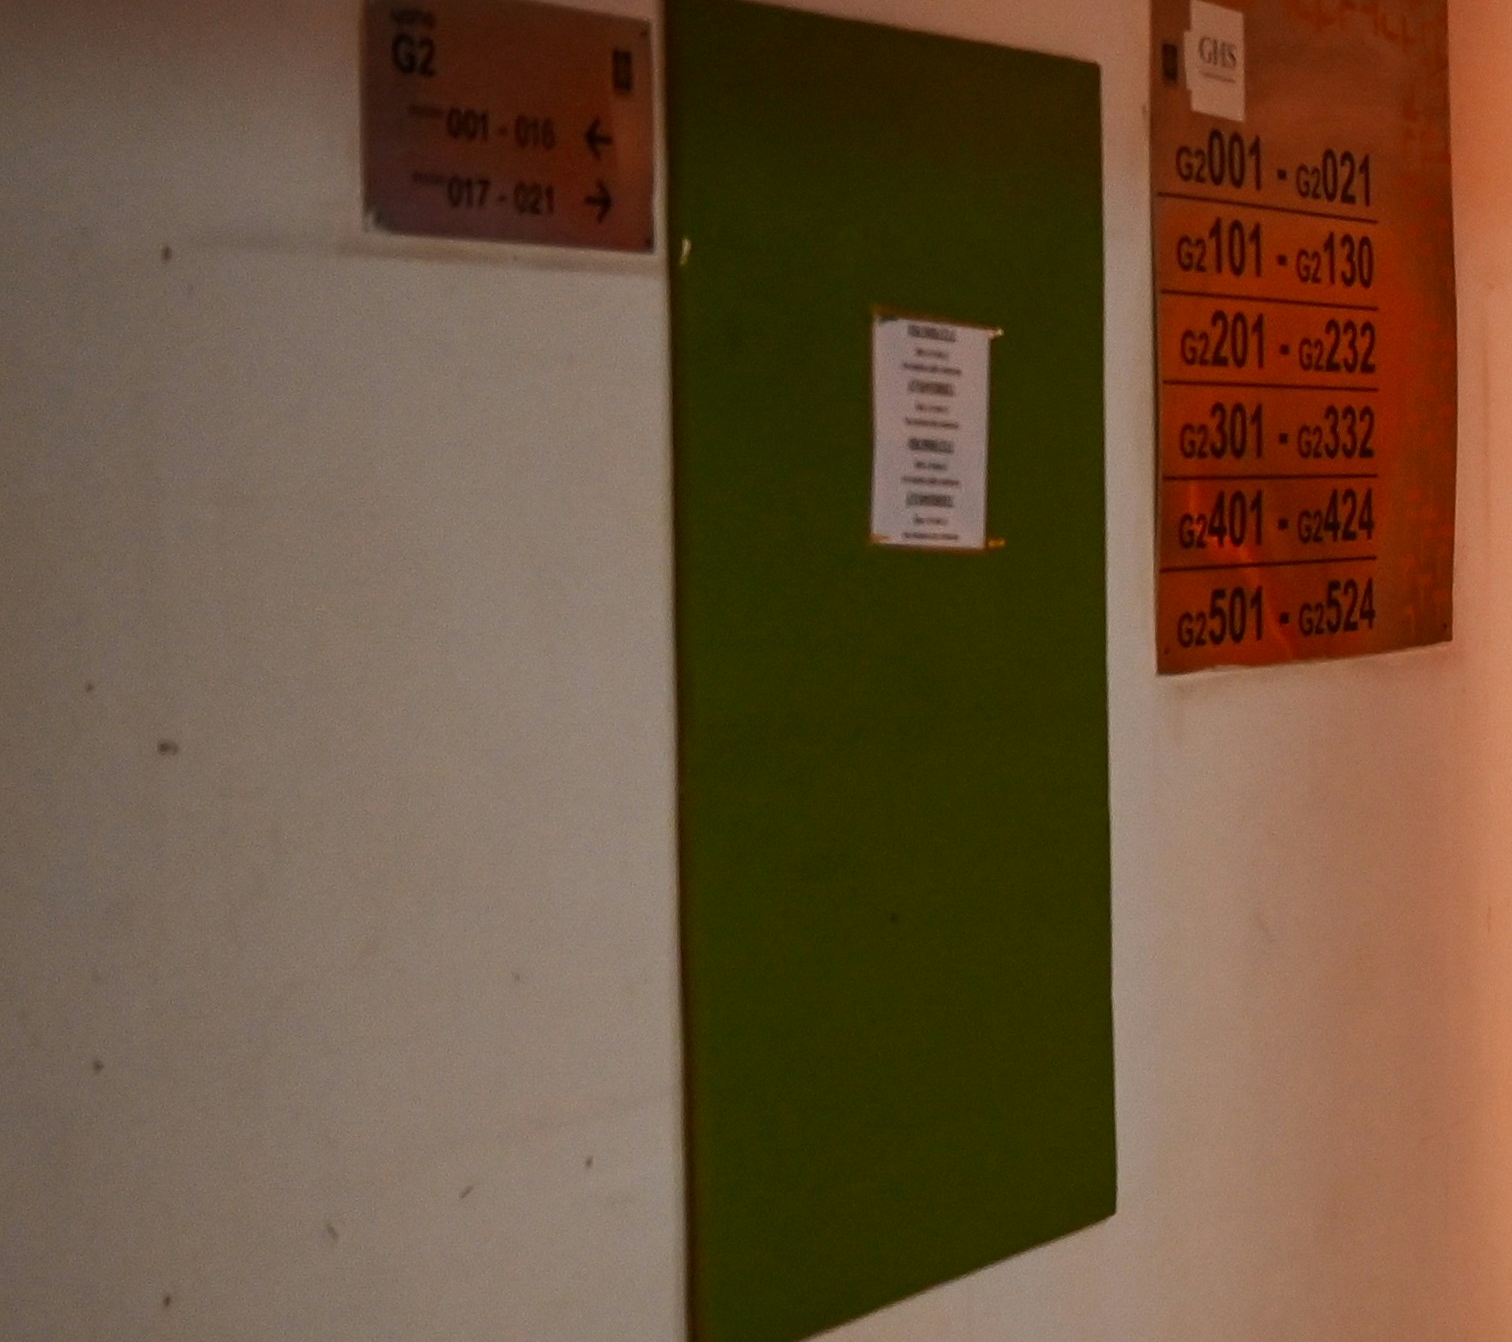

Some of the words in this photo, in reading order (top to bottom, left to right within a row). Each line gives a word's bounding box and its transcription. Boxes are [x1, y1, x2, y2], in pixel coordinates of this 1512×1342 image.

[392, 33, 436, 77] G2
[1199, 37, 1238, 69] GHS
[447, 109, 489, 143] 001
[447, 175, 491, 208] 017
[514, 181, 555, 215] 021
[1176, 129, 1262, 191] G2001
[1295, 148, 1371, 207] G2021
[1177, 217, 1262, 278] G2101
[1296, 231, 1374, 289] G2130
[1180, 310, 1264, 369] G2201
[1299, 318, 1376, 374] G2232
[1180, 402, 1263, 459] G2301
[1298, 405, 1375, 459] G2332
[1179, 490, 1263, 549] G2401
[1298, 487, 1375, 543] G2424
[1177, 585, 1263, 648] G2501
[1300, 577, 1376, 636] G2524
